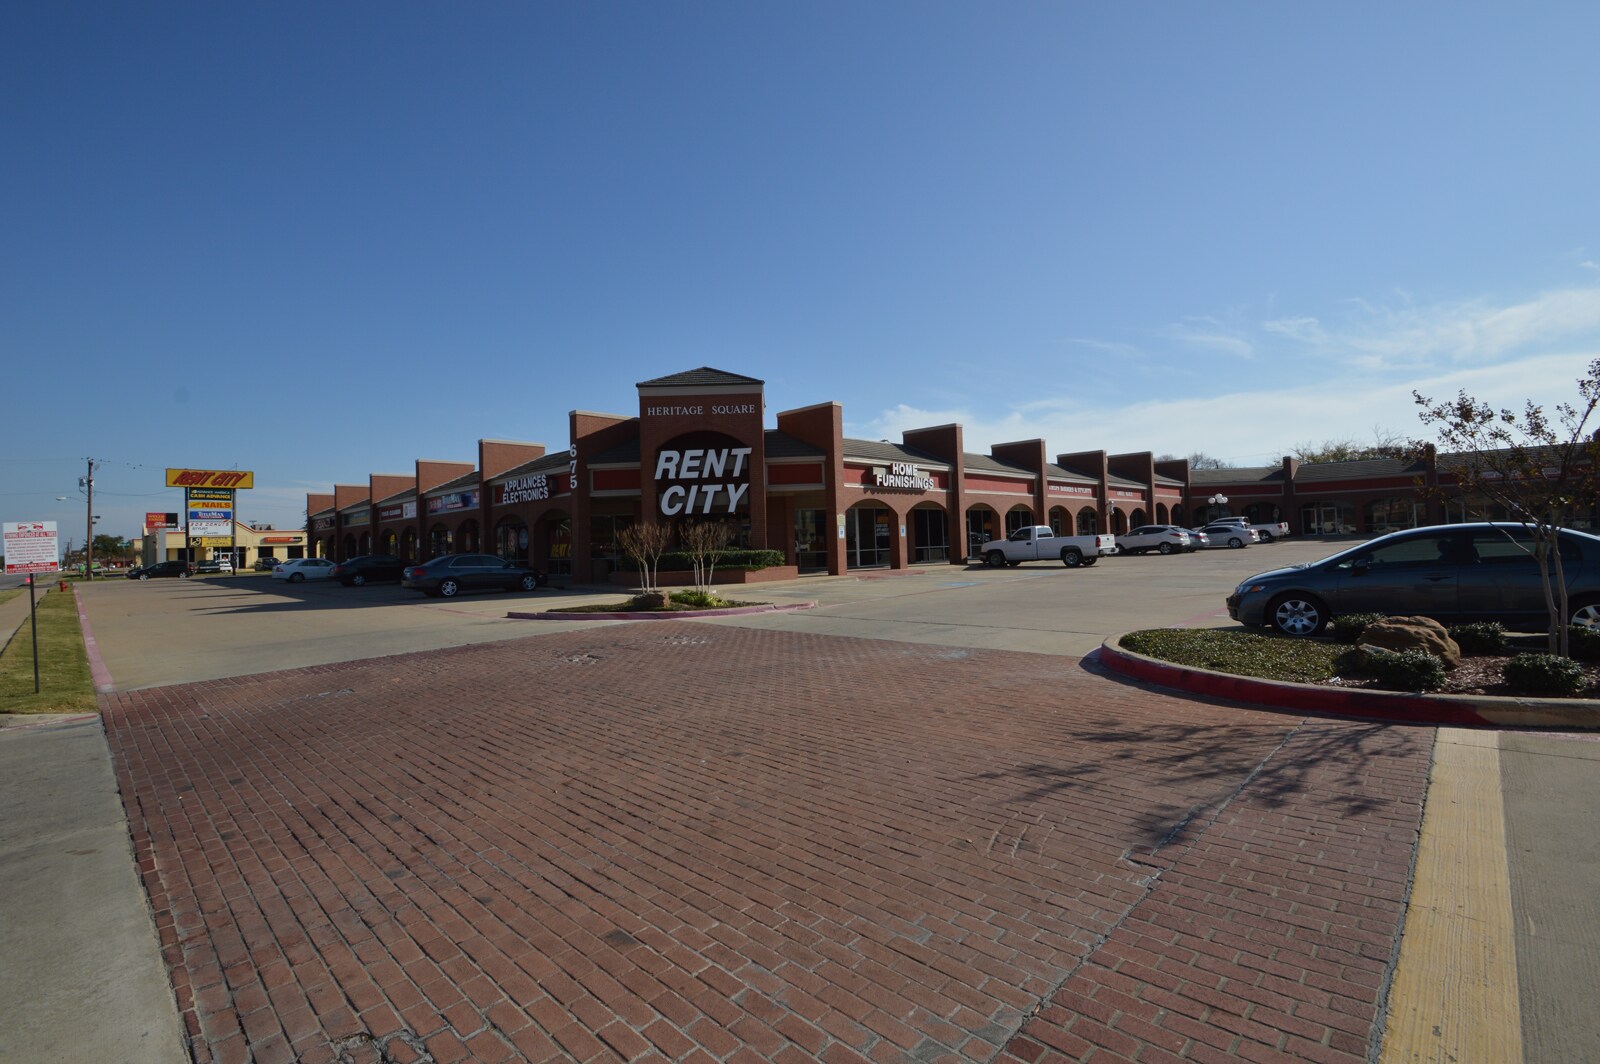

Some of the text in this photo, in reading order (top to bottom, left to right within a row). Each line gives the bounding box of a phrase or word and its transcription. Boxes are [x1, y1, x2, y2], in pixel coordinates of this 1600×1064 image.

[647, 404, 755, 416] HERITAGE SQUARE
[654, 447, 753, 480] RENT
[892, 462, 918, 476] HOME
[172, 471, 248, 487] RENT CITY
[504, 474, 547, 492] APPLIANCES
[876, 474, 934, 489] FURNISHINGS
[502, 486, 549, 504] ELECTRONICS
[660, 483, 750, 516] CITY
